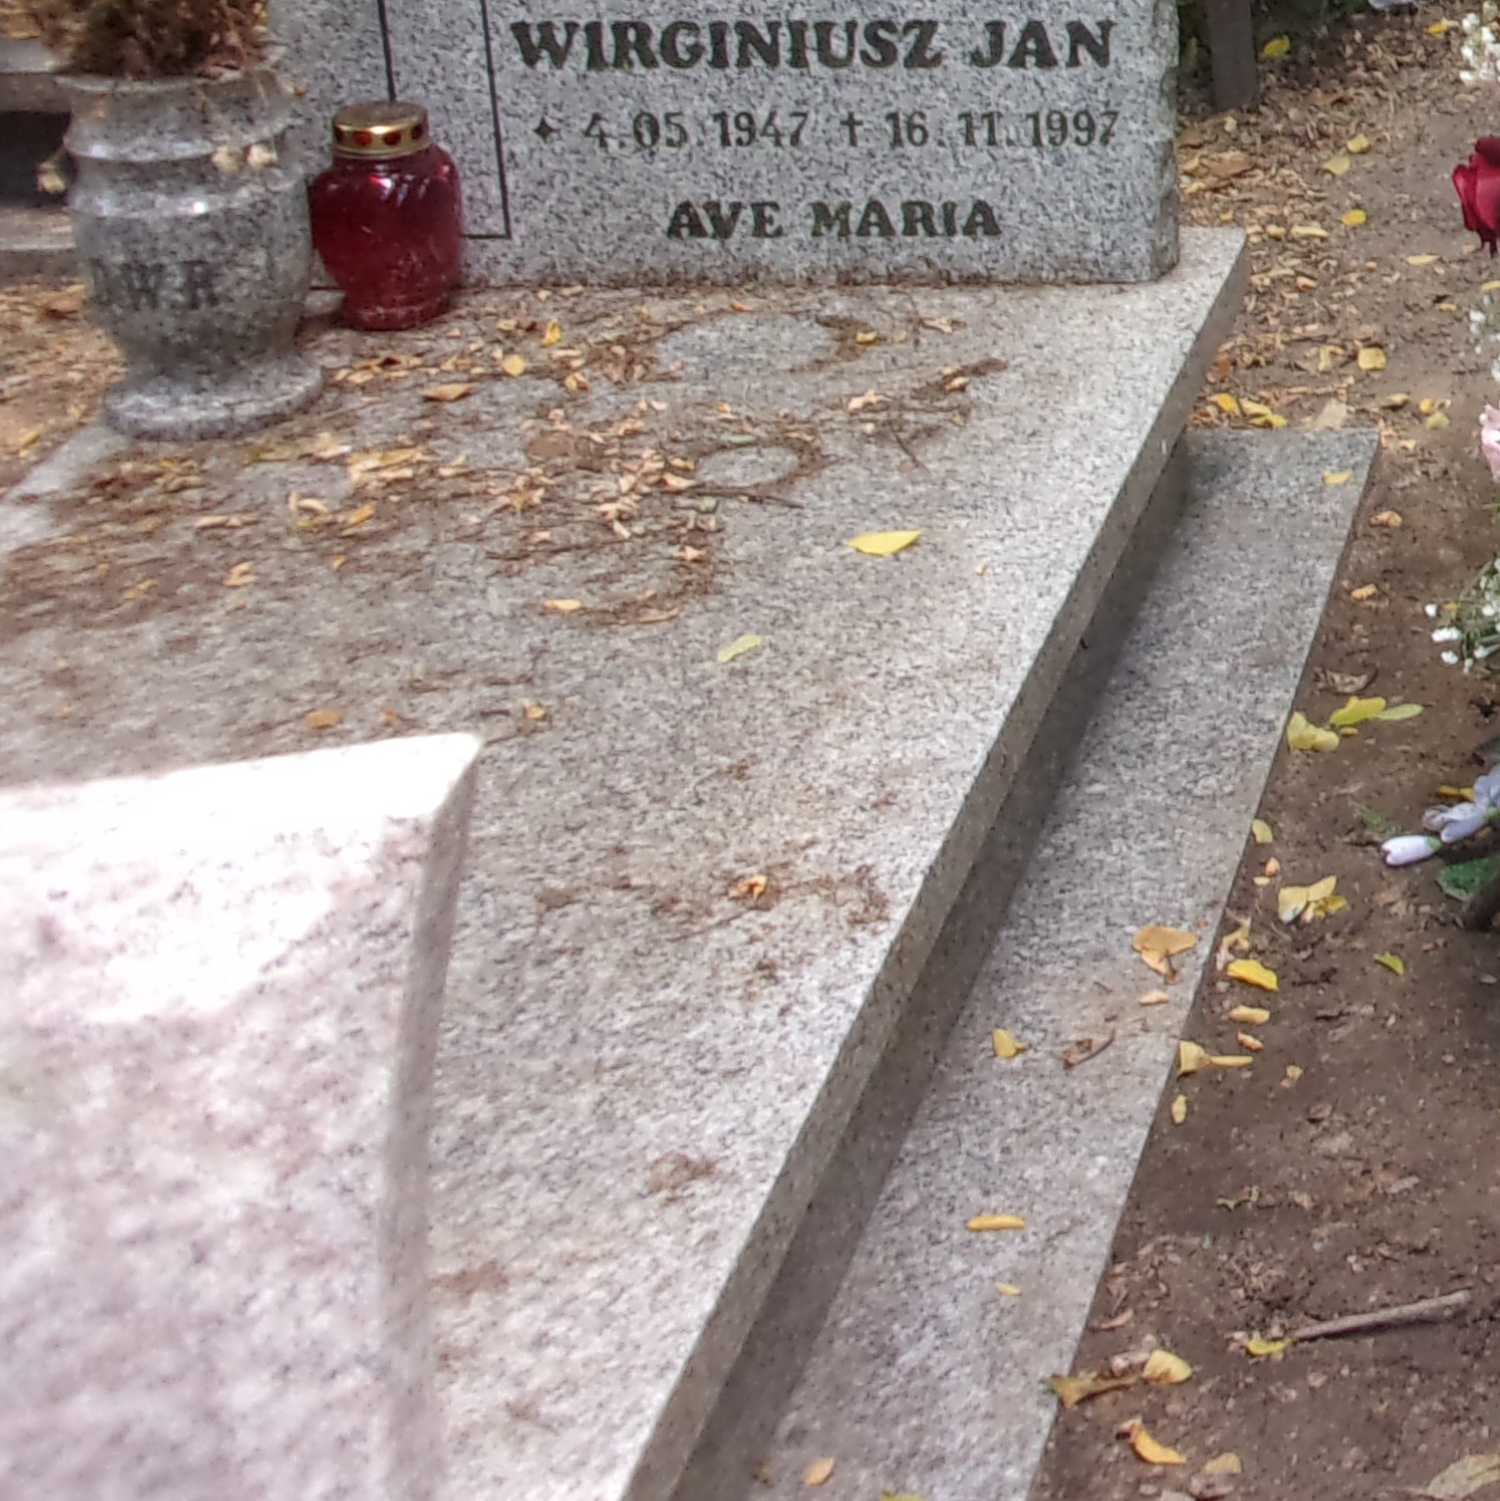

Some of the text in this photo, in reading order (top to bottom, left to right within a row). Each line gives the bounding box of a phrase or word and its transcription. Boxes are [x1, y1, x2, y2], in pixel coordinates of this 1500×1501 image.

[510, 18, 1118, 71] WIRGINIUSZ JAN
[666, 201, 1003, 240] AVE MARIA
